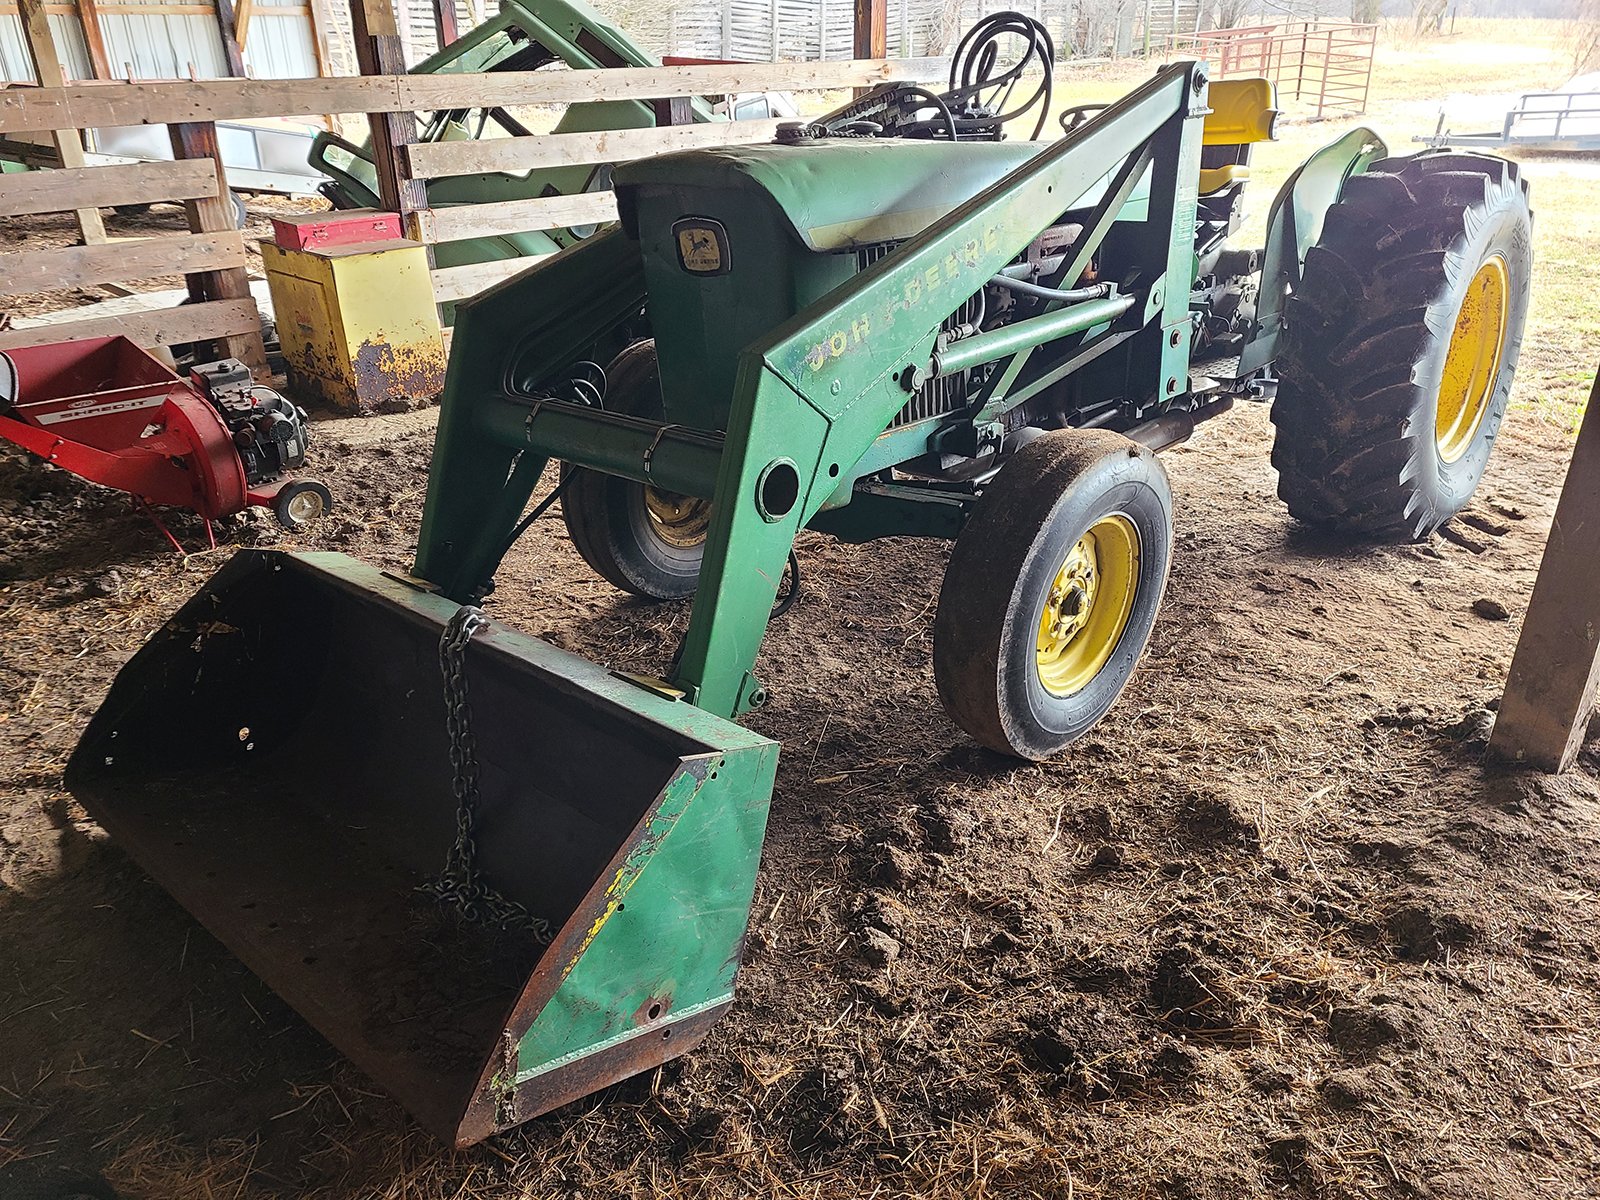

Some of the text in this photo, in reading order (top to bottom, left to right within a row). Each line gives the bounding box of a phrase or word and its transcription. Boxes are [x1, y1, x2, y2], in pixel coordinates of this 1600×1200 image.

[808, 227, 999, 372] JOH DEERE
[59, 400, 148, 419] SHRED-IT
